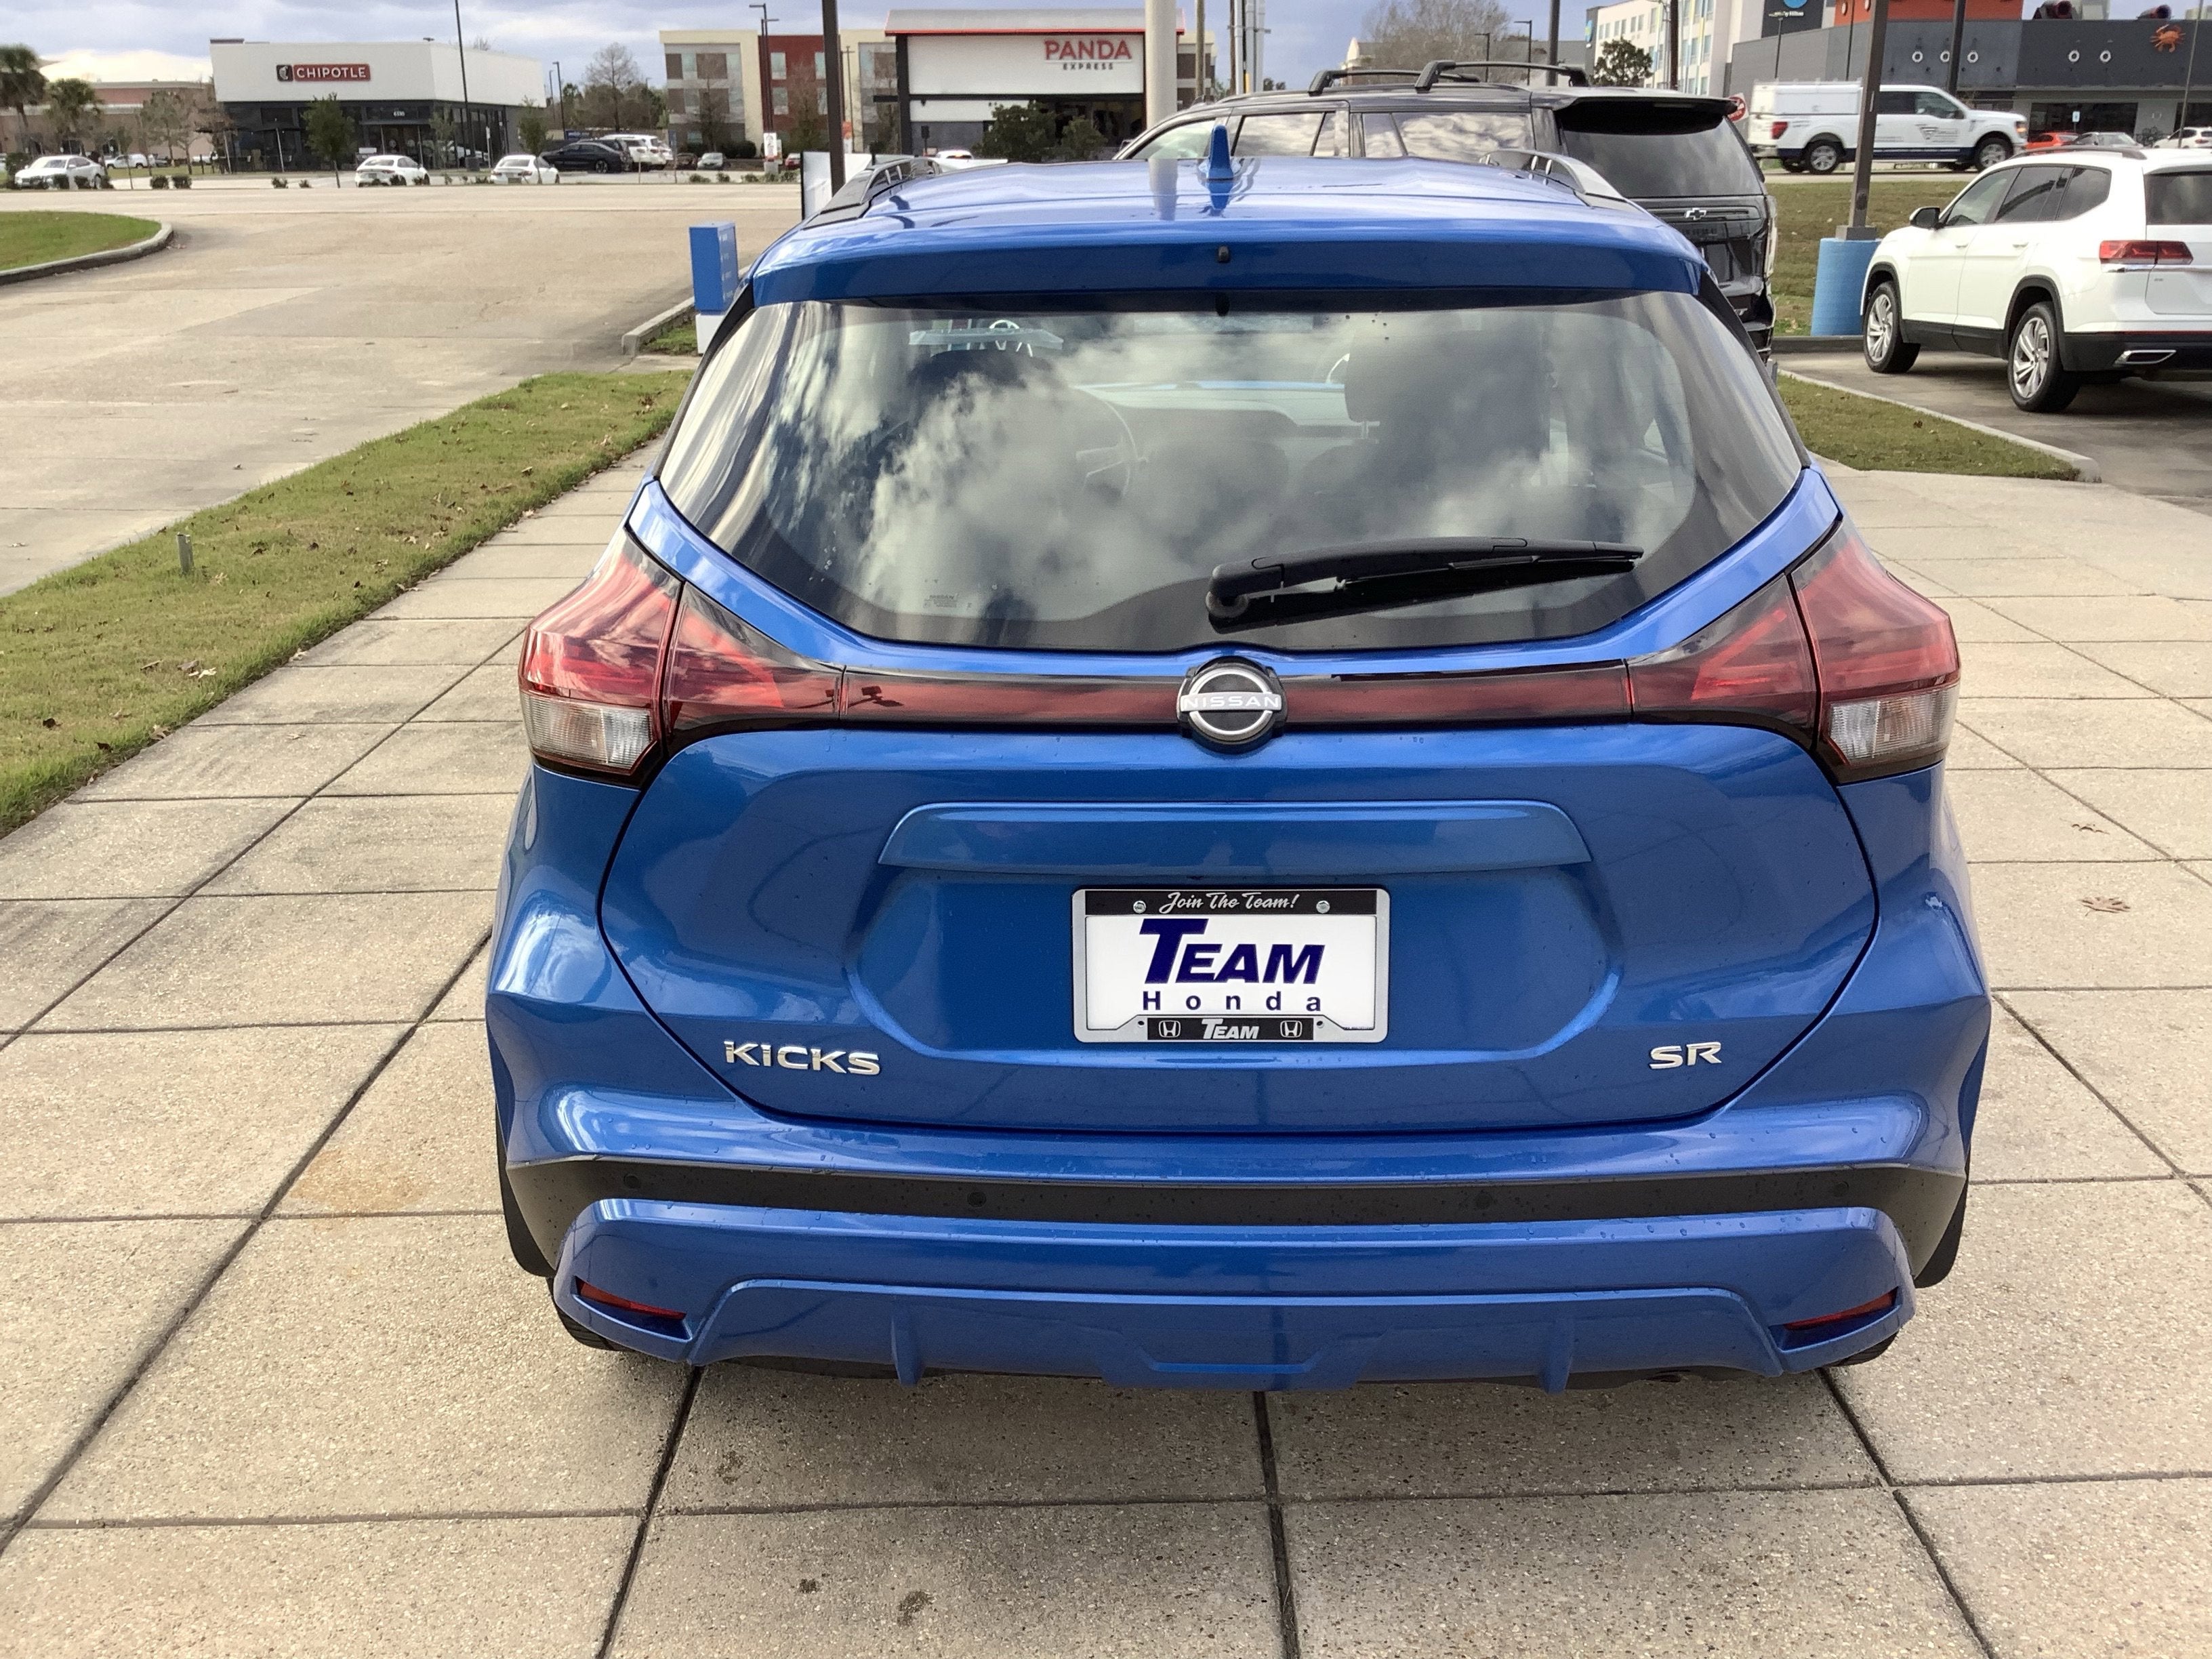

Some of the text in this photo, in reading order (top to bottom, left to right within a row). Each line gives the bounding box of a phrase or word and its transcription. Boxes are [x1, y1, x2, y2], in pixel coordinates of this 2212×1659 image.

[1044, 40, 1132, 60] PANDA
[296, 67, 366, 78] CHIPOTLE
[1185, 695, 1279, 708] NISSAN
[1158, 891, 1300, 914] Join The Team!
[1139, 918, 1326, 984] TEAM
[1143, 991, 1322, 1011] Honda
[1202, 1018, 1259, 1040] TEAM
[724, 1041, 880, 1076] KICKS
[1649, 1042, 1722, 1069] SR
